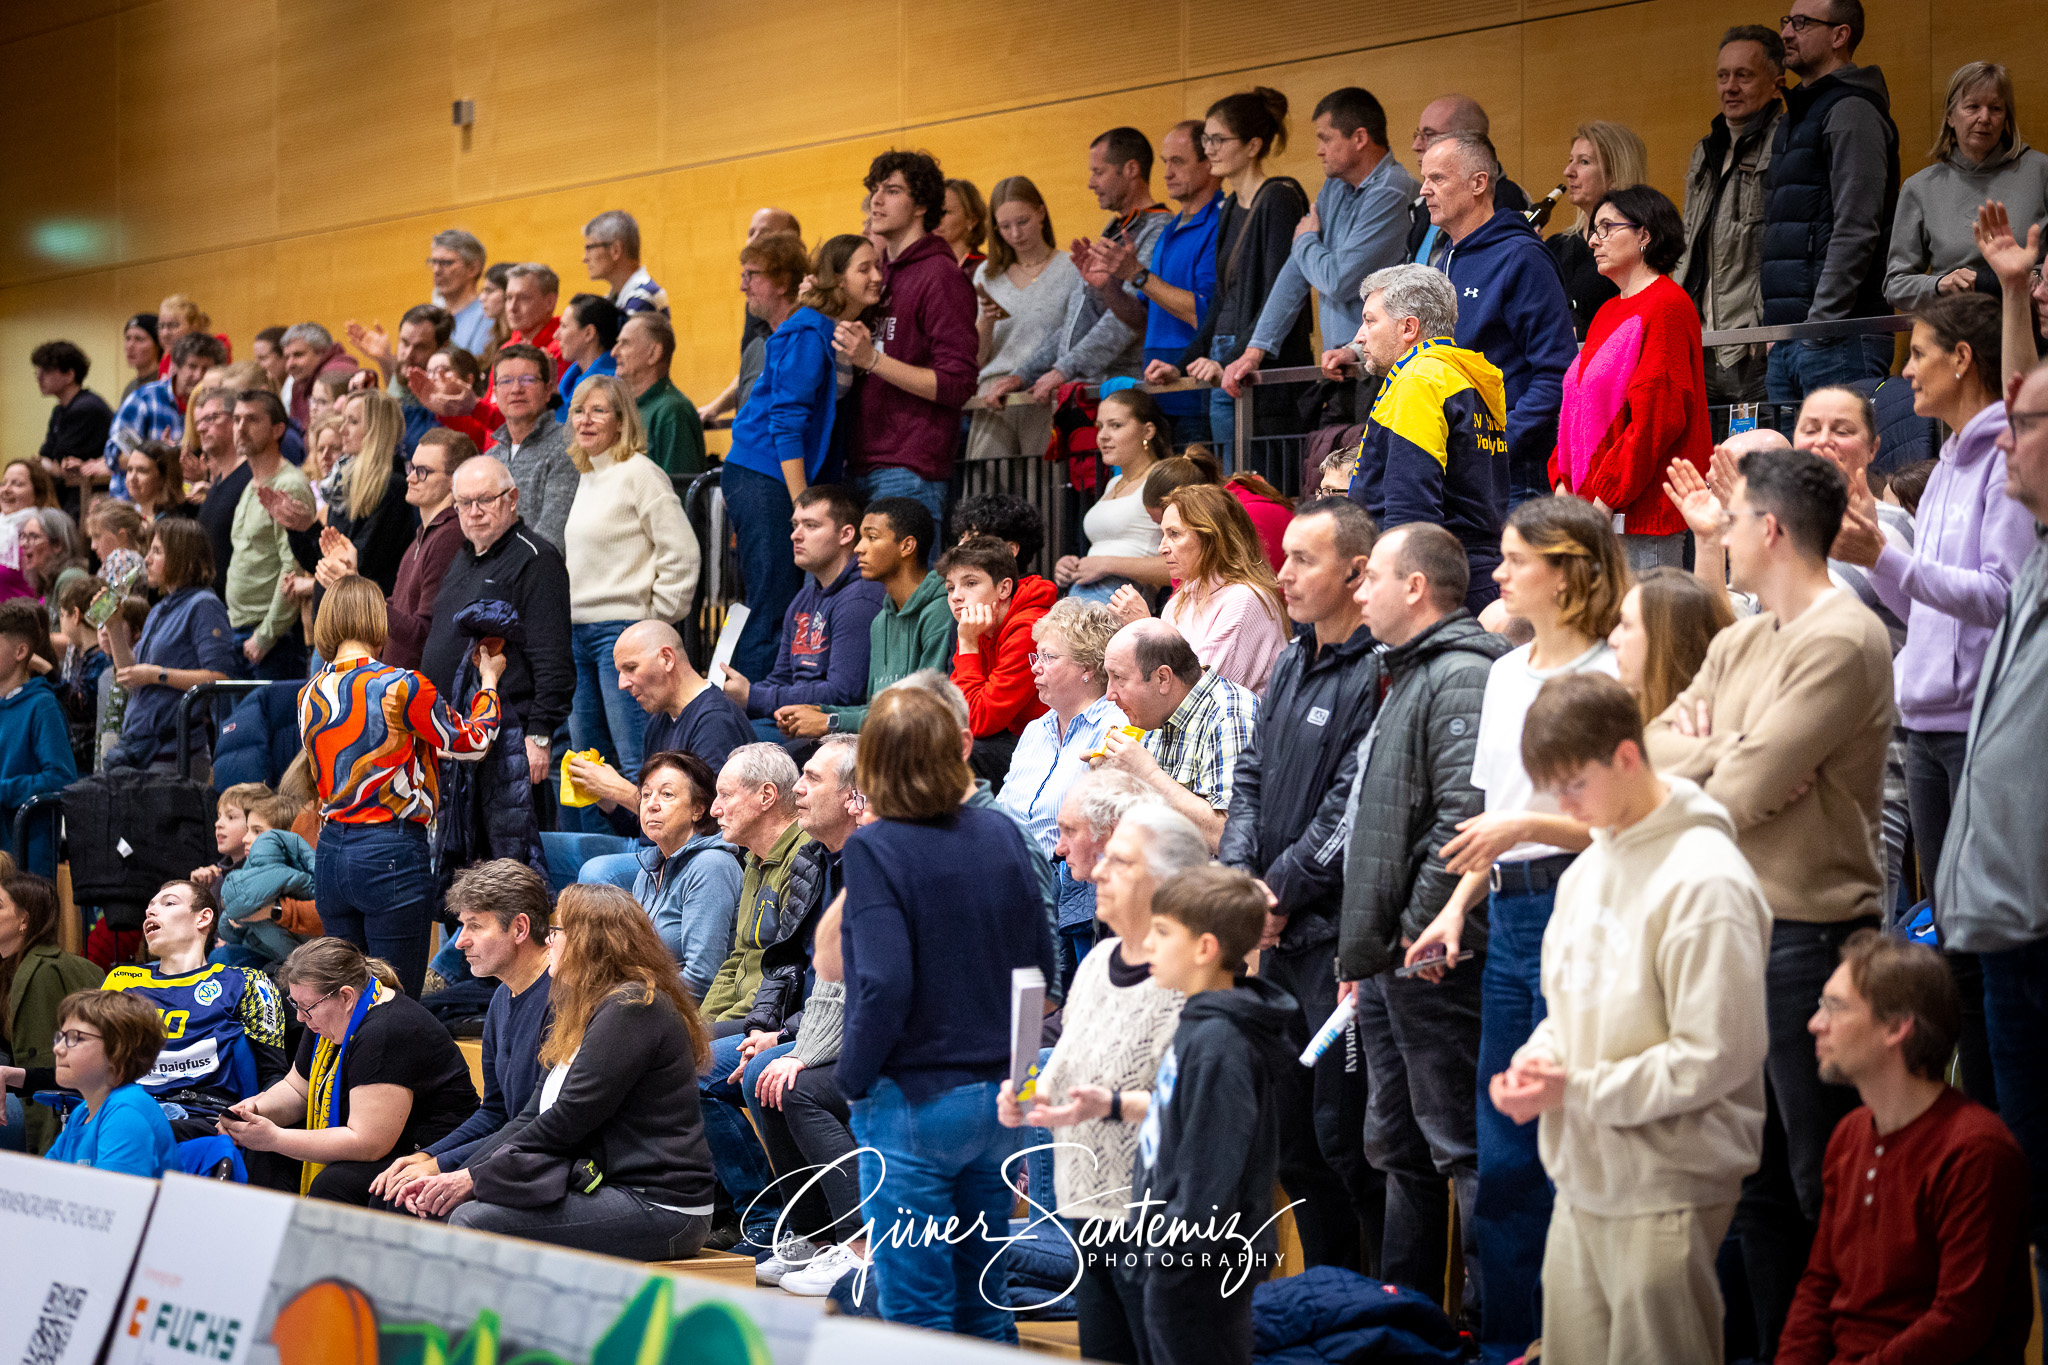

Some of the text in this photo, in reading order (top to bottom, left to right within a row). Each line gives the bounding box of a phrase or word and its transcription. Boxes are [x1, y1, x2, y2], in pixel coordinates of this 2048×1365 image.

[113, 970, 142, 979] Kempa
[266, 1003, 275, 1026] puls
[1344, 1023, 1357, 1073] ARMANI
[159, 1057, 211, 1073] Daigfuss
[151, 1302, 242, 1361] FUCHS
